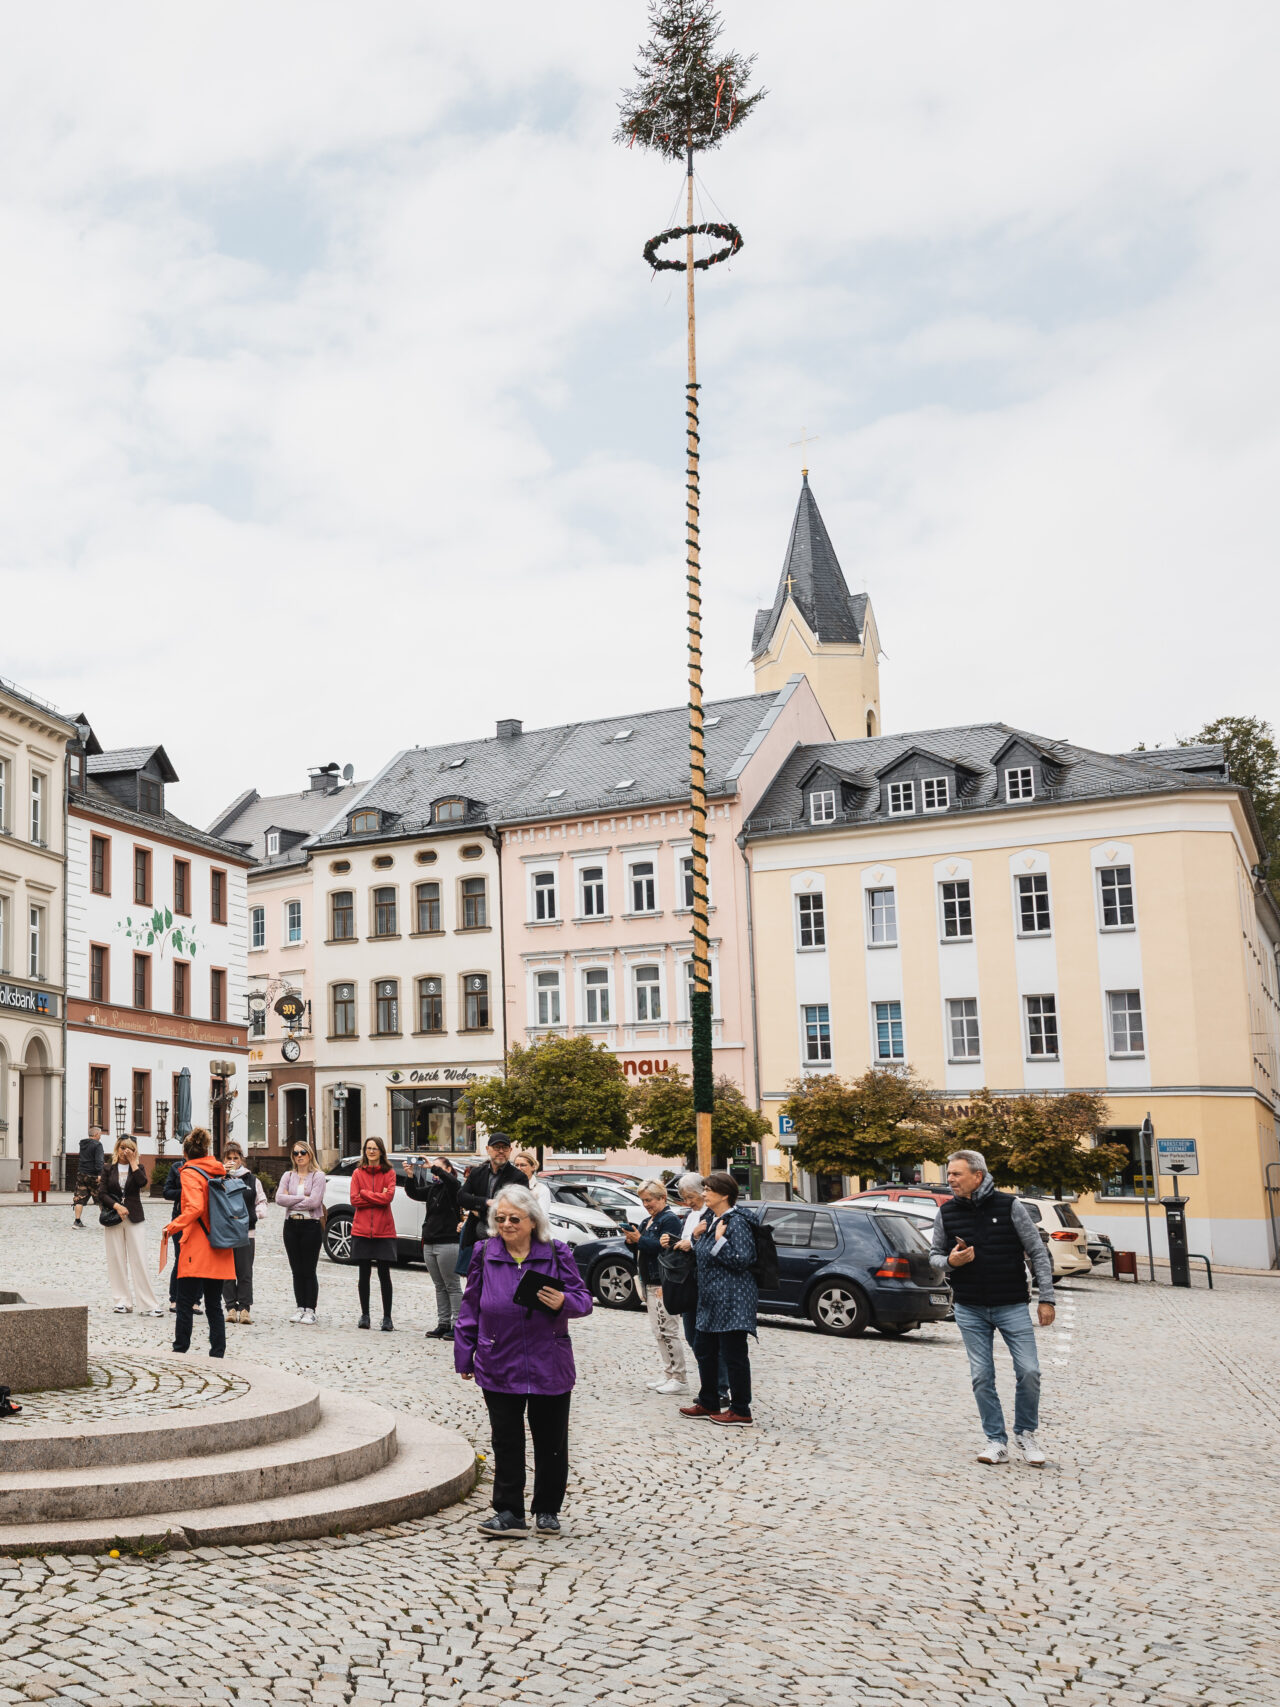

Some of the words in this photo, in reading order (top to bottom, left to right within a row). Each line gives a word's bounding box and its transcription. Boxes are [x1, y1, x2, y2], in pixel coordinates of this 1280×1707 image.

[250, 1050, 264, 1060] ne
[622, 1060, 668, 1076] nau
[410, 1070, 440, 1083] Optik
[443, 1068, 477, 1081] Weber
[782, 1118, 794, 1132] P
